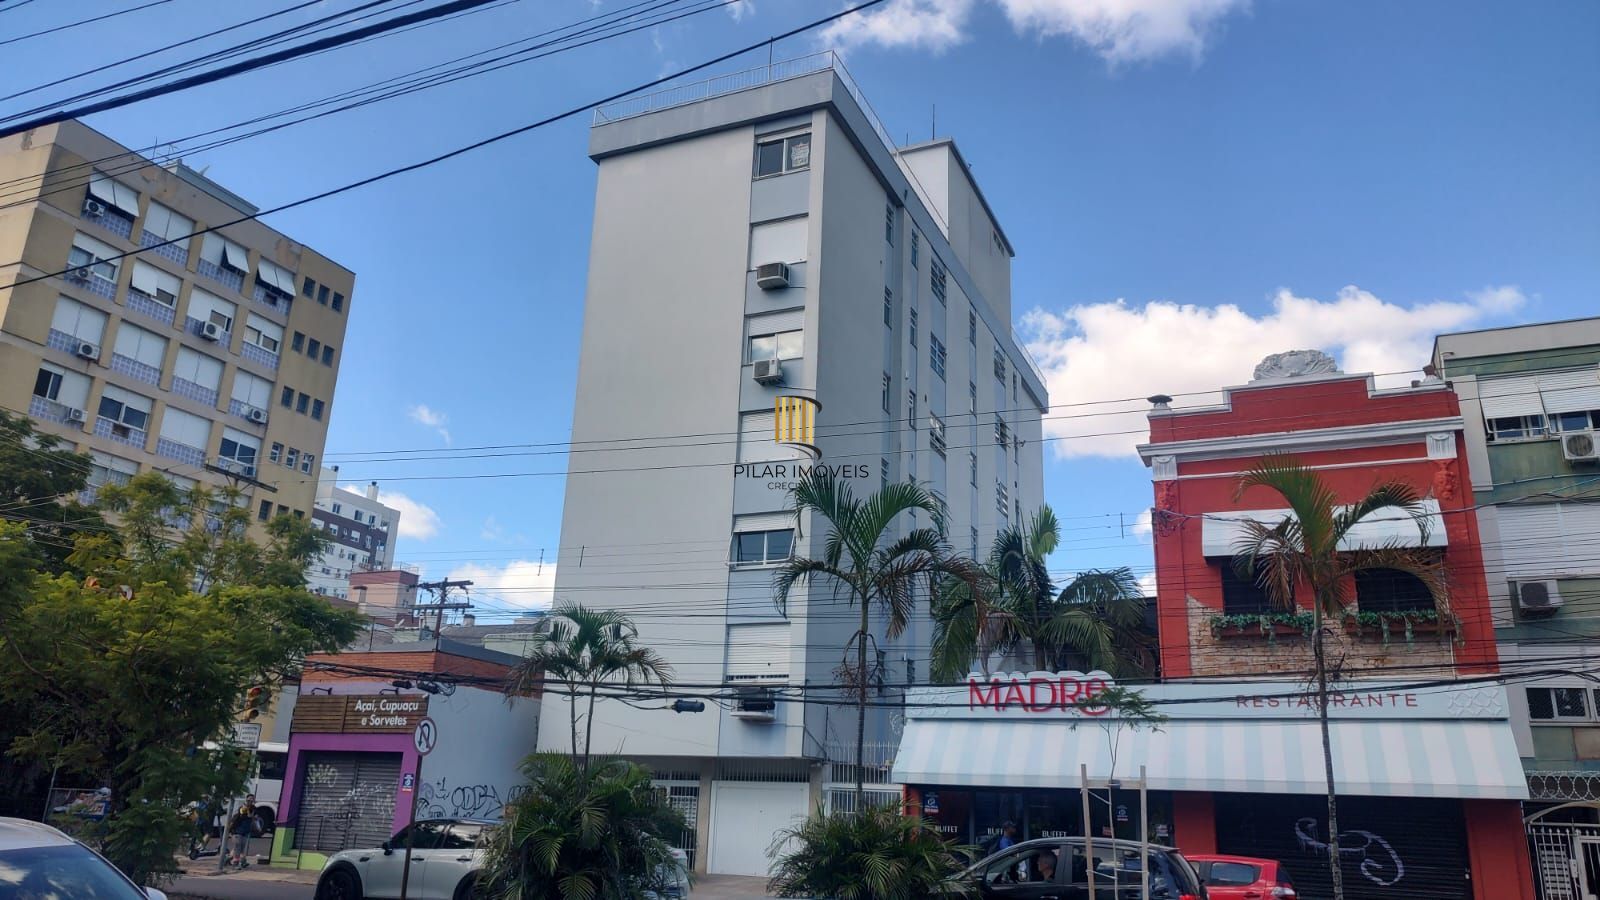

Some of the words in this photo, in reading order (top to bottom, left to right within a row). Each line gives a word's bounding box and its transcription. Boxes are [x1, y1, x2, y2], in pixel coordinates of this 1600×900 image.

[354, 699, 377, 712] Açaí,
[379, 699, 419, 714] Cupuaçu
[361, 717, 368, 726] e
[369, 714, 408, 726] Sorvetes
